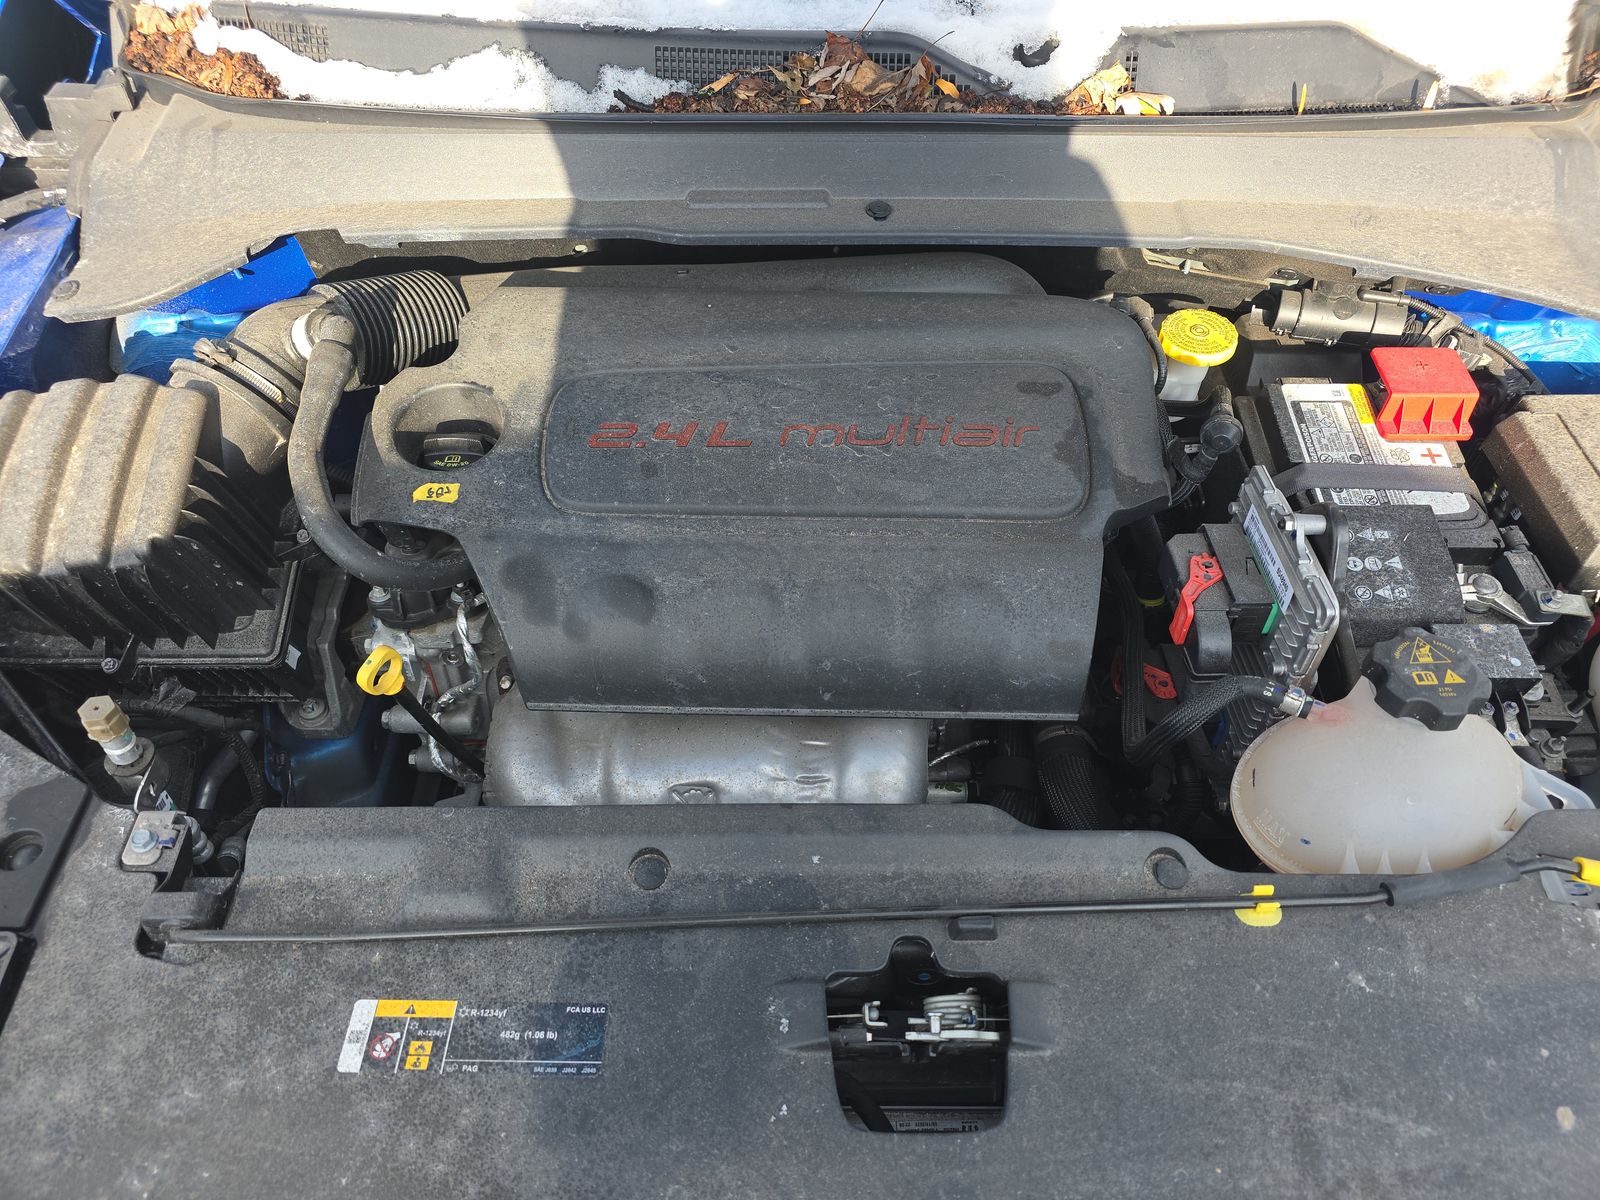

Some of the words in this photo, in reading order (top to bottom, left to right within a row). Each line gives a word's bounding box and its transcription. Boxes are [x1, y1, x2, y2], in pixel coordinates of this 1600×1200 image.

[779, 415, 1041, 448] multiair
[470, 1008, 508, 1019] R-1234yf
[566, 1006, 580, 1014] FCA
[462, 1064, 479, 1073] PAG
